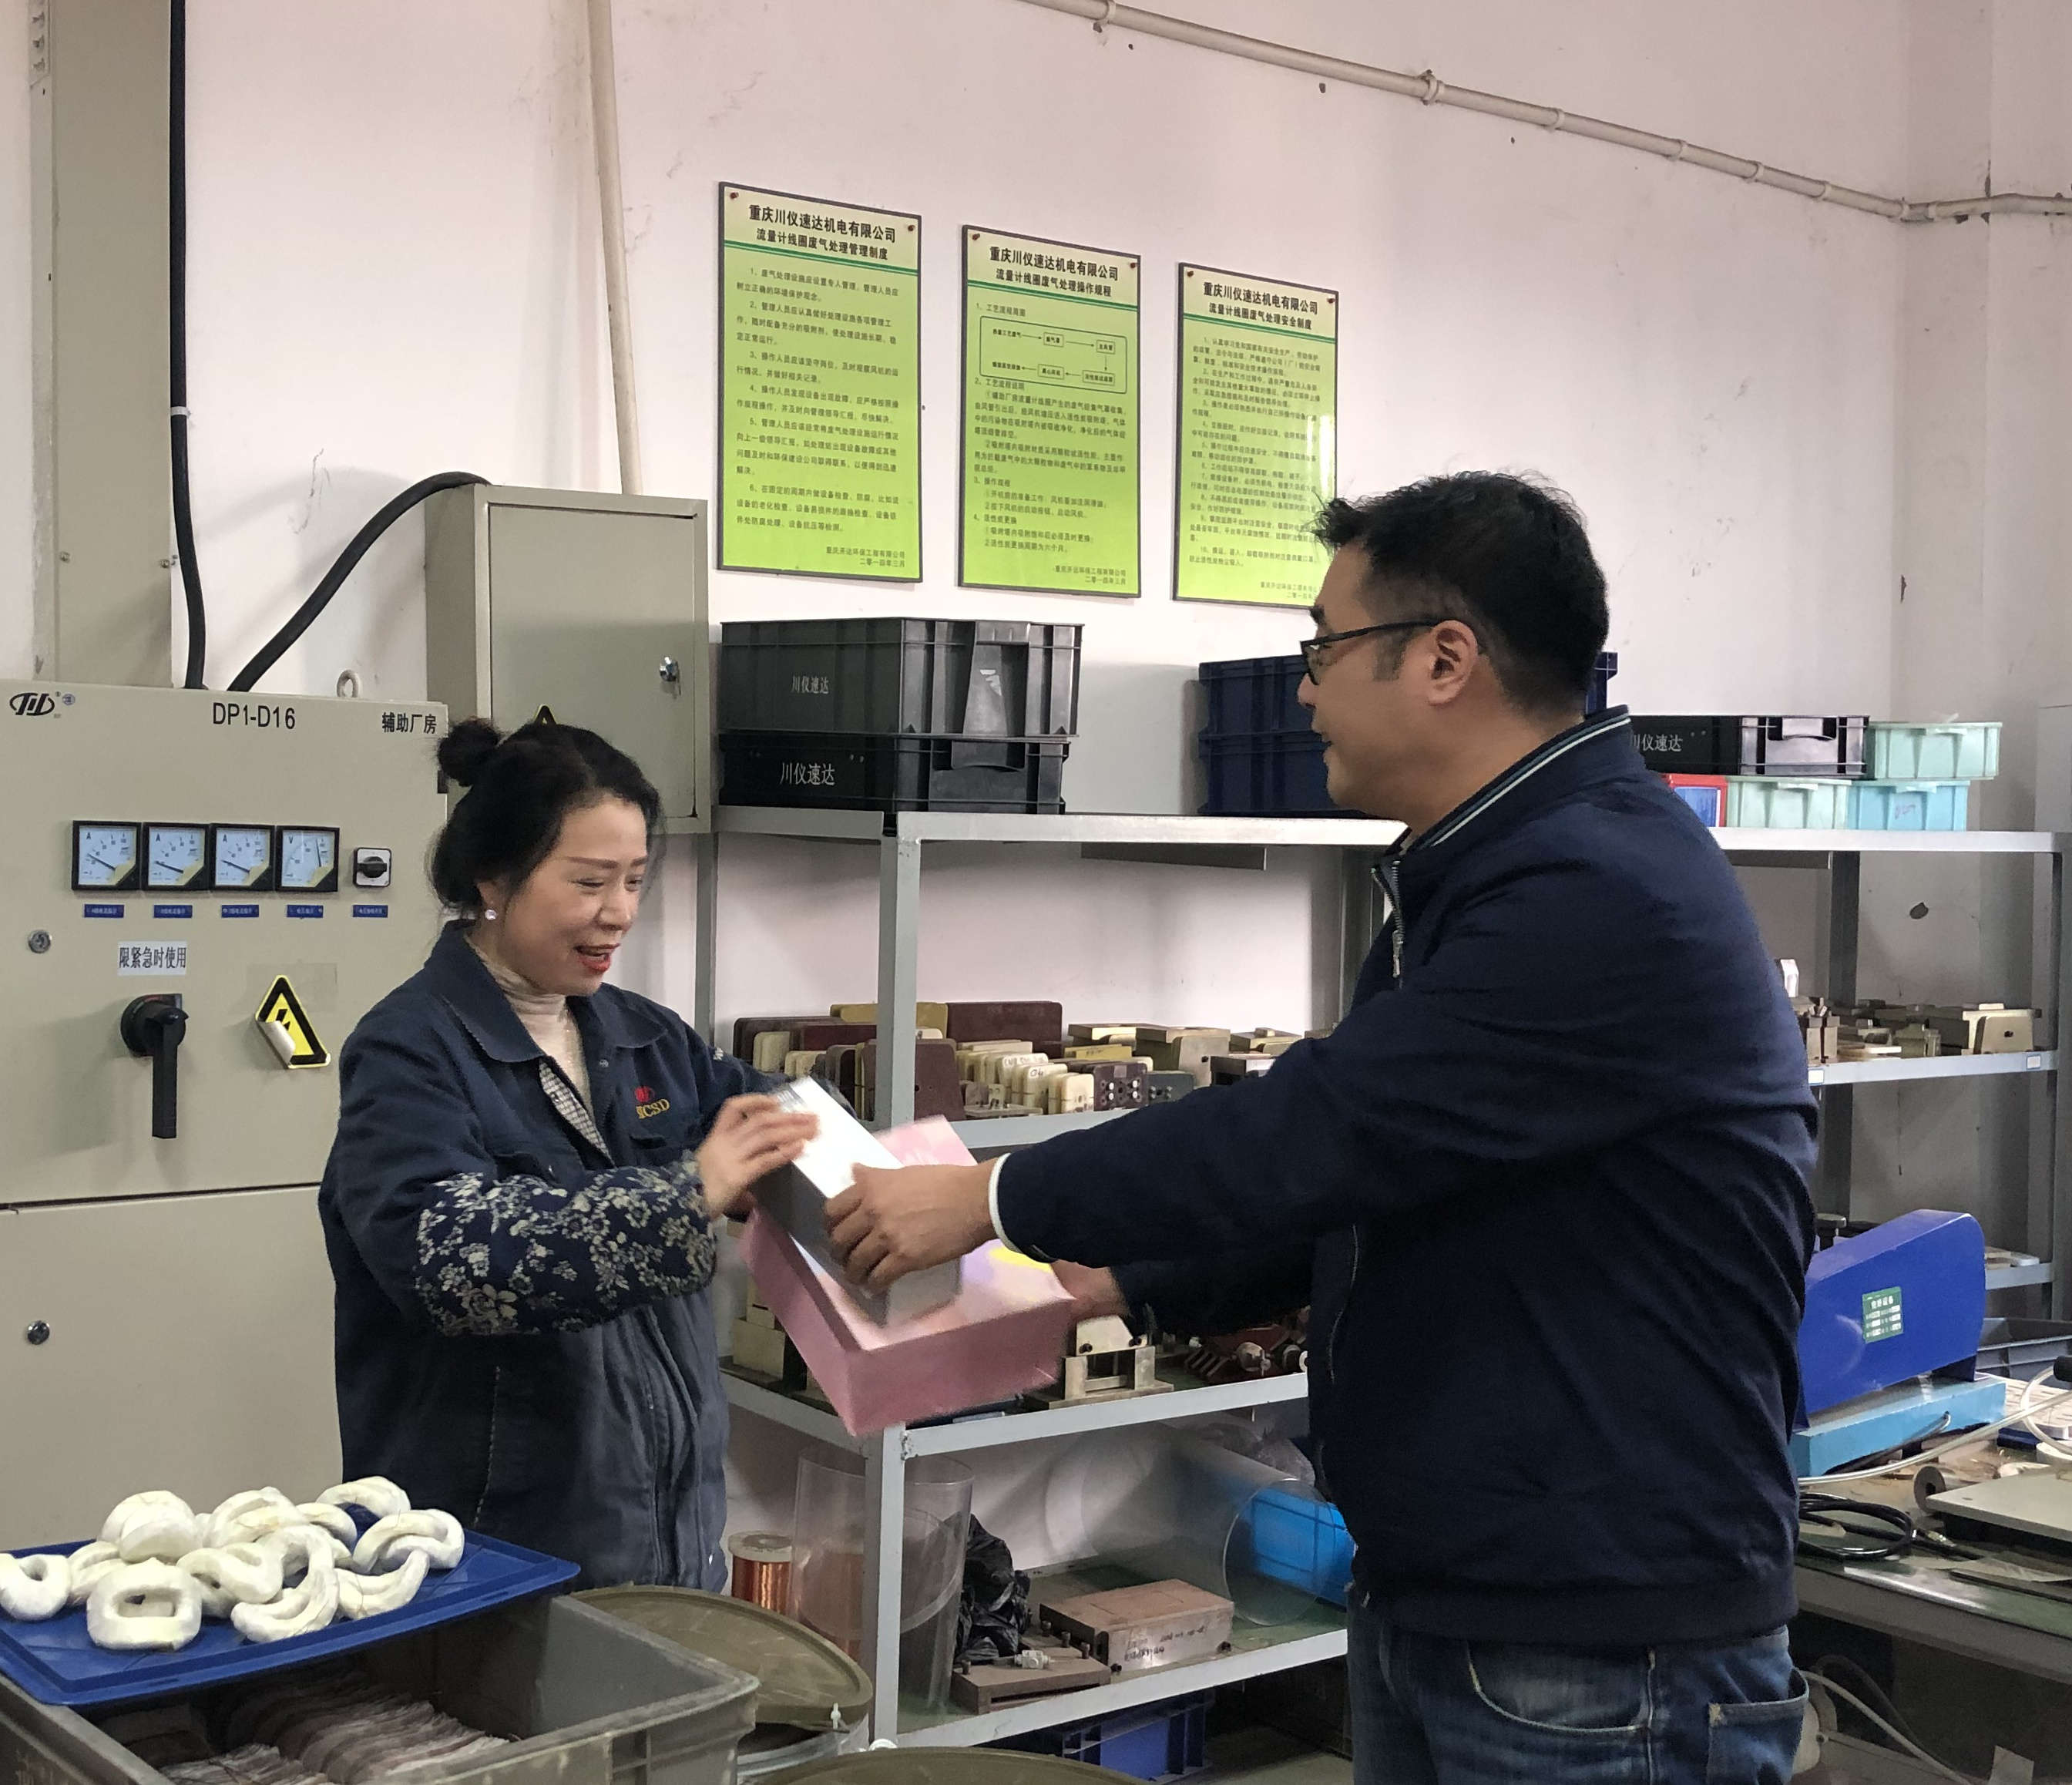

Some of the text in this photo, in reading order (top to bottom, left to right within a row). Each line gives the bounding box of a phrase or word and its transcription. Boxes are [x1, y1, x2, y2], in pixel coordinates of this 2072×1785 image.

[749, 204, 895, 242] 重庆川仪速达机电有限公司
[757, 227, 887, 260] 流量计线圈废气处理管理制度
[989, 246, 1117, 280] 重庆川仪速达机电有限公司
[996, 267, 1110, 297] 流量计线圈废气处理操作规程
[1203, 281, 1317, 314] 重庆川仪速达机电有限公司
[1209, 302, 1311, 329] 流量计线圈废气处理安全制度
[791, 676, 829, 694] 川仪速达
[213, 702, 295, 729] DP1-D16
[381, 711, 437, 734] 辅助厂房
[780, 762, 835, 785] 川仪速达
[86, 832, 92, 840] A
[156, 833, 161, 842] A
[223, 834, 227, 842] A
[119, 946, 186, 968] 限紧急时使用
